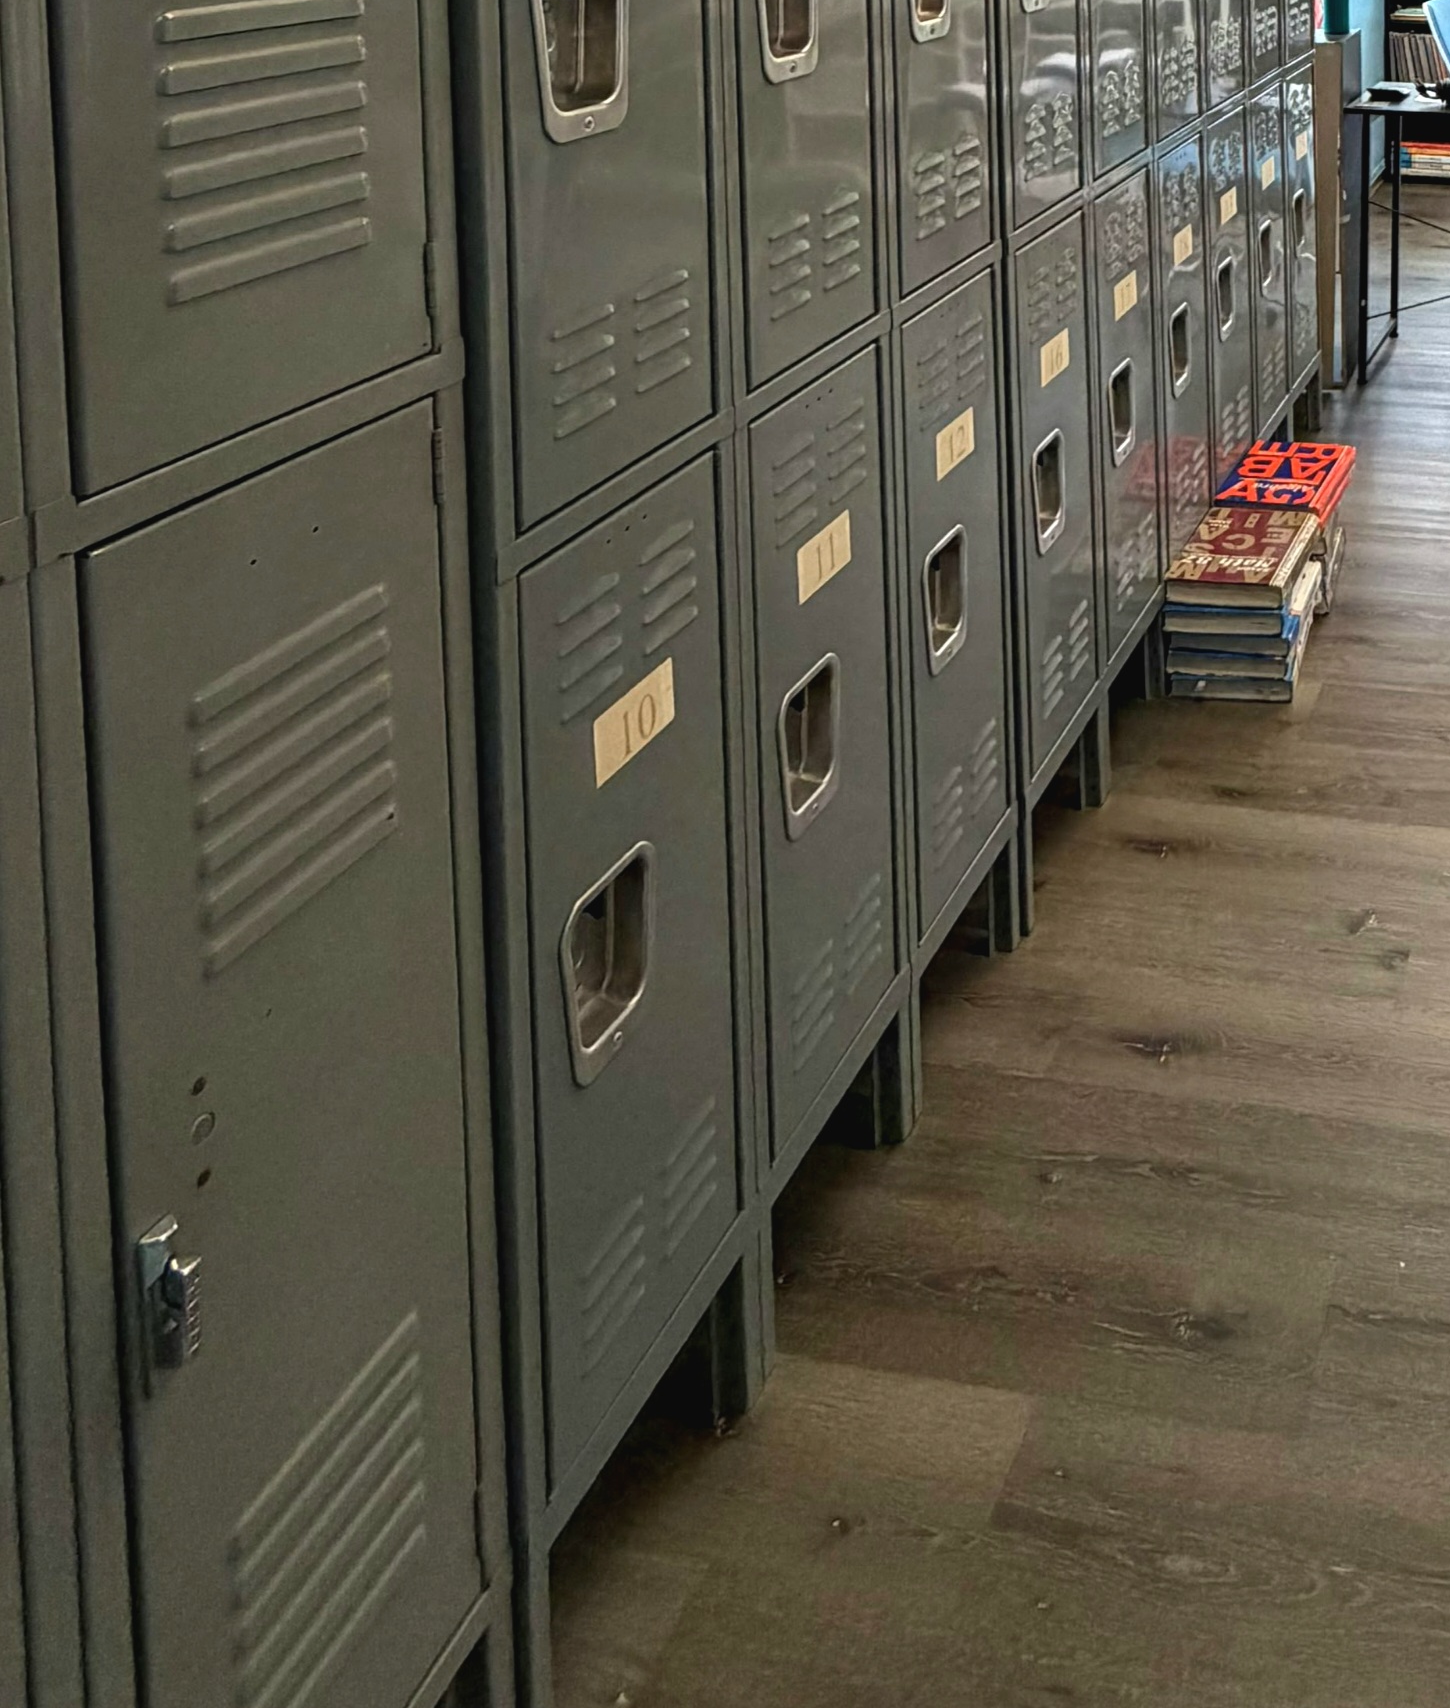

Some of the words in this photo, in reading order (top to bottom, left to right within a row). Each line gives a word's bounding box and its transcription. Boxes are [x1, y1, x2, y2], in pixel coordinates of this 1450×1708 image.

[1050, 341, 1064, 375] 16
[949, 425, 966, 463] 12
[816, 533, 835, 581] 11
[622, 694, 657, 759] 10
